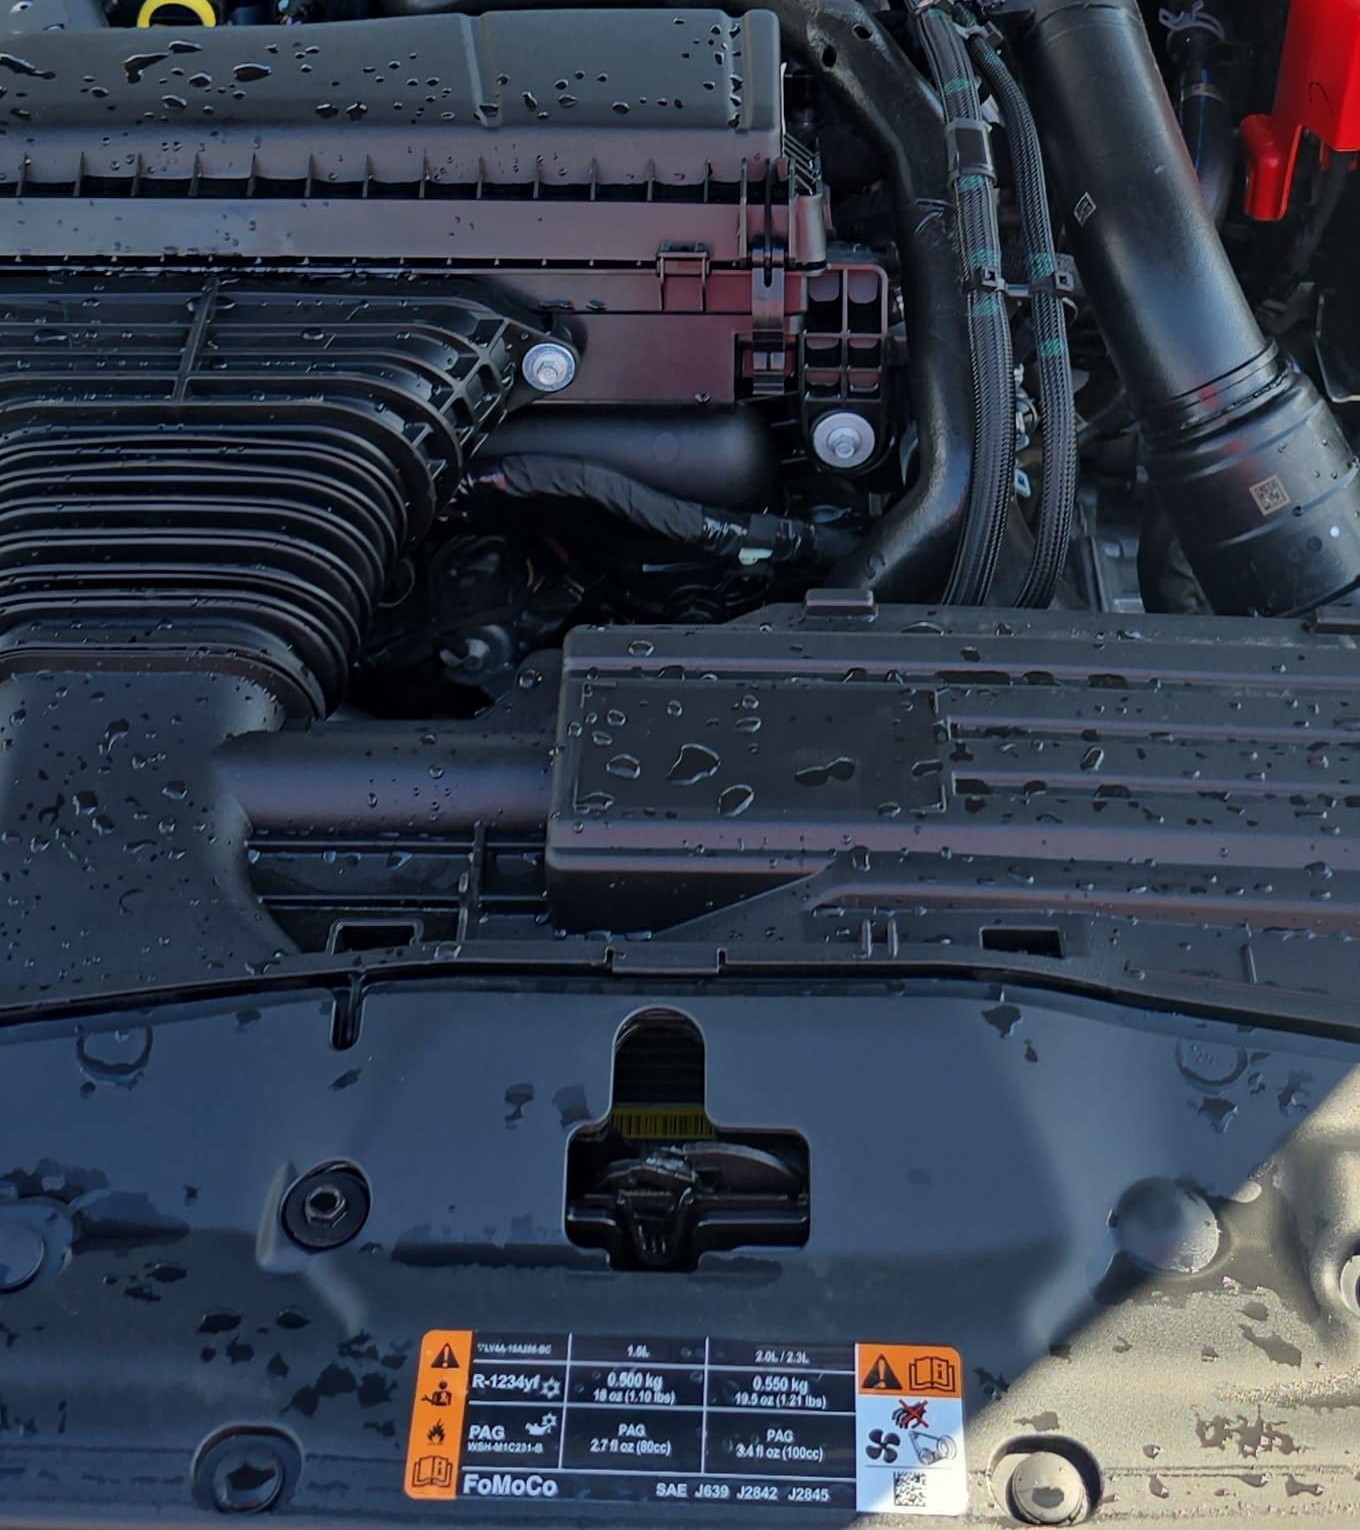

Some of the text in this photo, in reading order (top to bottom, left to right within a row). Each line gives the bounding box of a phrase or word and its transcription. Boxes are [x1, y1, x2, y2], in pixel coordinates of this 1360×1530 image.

[754, 1349, 778, 1363] 2.0L
[471, 1373, 541, 1392] R-1234yf
[607, 1371, 664, 1390] 0.500 kg
[752, 1375, 809, 1394] 0.550 kg
[609, 1391, 624, 1402] oz
[624, 1389, 653, 1404] (1.10
[653, 1390, 676, 1405] lbs)
[759, 1395, 775, 1406] oz
[775, 1393, 802, 1408] (1.21
[804, 1394, 827, 1409] lbs)
[469, 1424, 505, 1440] PAG
[618, 1423, 646, 1437] PAG
[766, 1428, 794, 1442] PAG
[589, 1438, 609, 1453] 2.7
[609, 1438, 619, 1453] fl
[619, 1442, 634, 1454] oz
[735, 1445, 824, 1462] 3.4 fl oz (100cc)
[462, 1473, 558, 1497] FoMoCo
[656, 1482, 830, 1502] SAE J639 J2842 J2845
